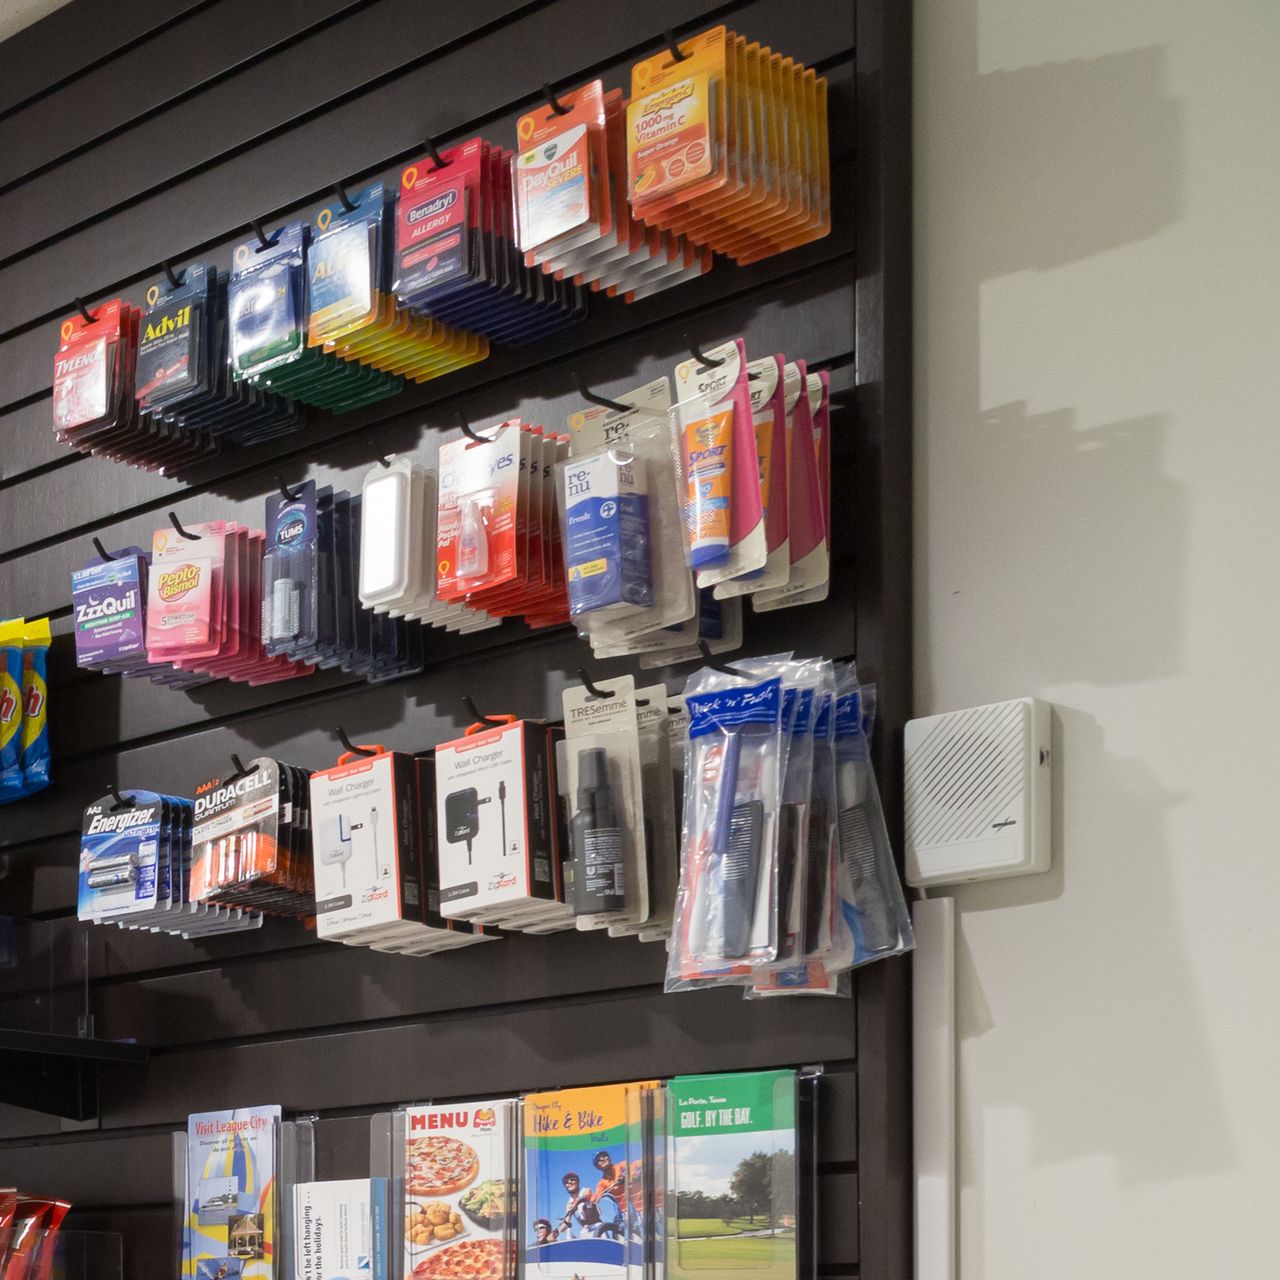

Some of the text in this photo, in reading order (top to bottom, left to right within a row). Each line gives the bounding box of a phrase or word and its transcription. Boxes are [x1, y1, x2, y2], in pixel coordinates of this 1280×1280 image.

[635, 120, 677, 143] Vitamin
[523, 152, 577, 190] DayQuil
[546, 165, 583, 188] SEVERE
[408, 191, 454, 223] Benadryl
[411, 213, 451, 238] ALLERGY
[142, 306, 192, 344] Advil
[688, 445, 728, 467] SPORT
[569, 481, 591, 497] nu
[280, 523, 304, 539] TUMS
[159, 565, 200, 589] Pepto-
[163, 575, 199, 598] Bismol
[77, 589, 136, 622] ZzzQuil
[570, 699, 628, 719] TRESemmé
[454, 749, 504, 770] Wall Charger
[194, 768, 271, 815] DURACELL
[328, 777, 375, 797] Wall Charger
[88, 807, 155, 835] Energizer
[709, 1096, 727, 1104] Texas
[195, 1115, 268, 1136] Visit League City
[411, 1111, 468, 1131] MENU
[533, 1112, 558, 1133] Hike
[578, 1110, 604, 1129] Bike
[681, 1107, 753, 1129] GOLF. BY THE BAY.
[302, 1206, 314, 1241] hanging
[313, 1215, 324, 1254] holidays.
[303, 1242, 312, 1257] left
[303, 1258, 312, 1269] be
[313, 1256, 323, 1270] the
